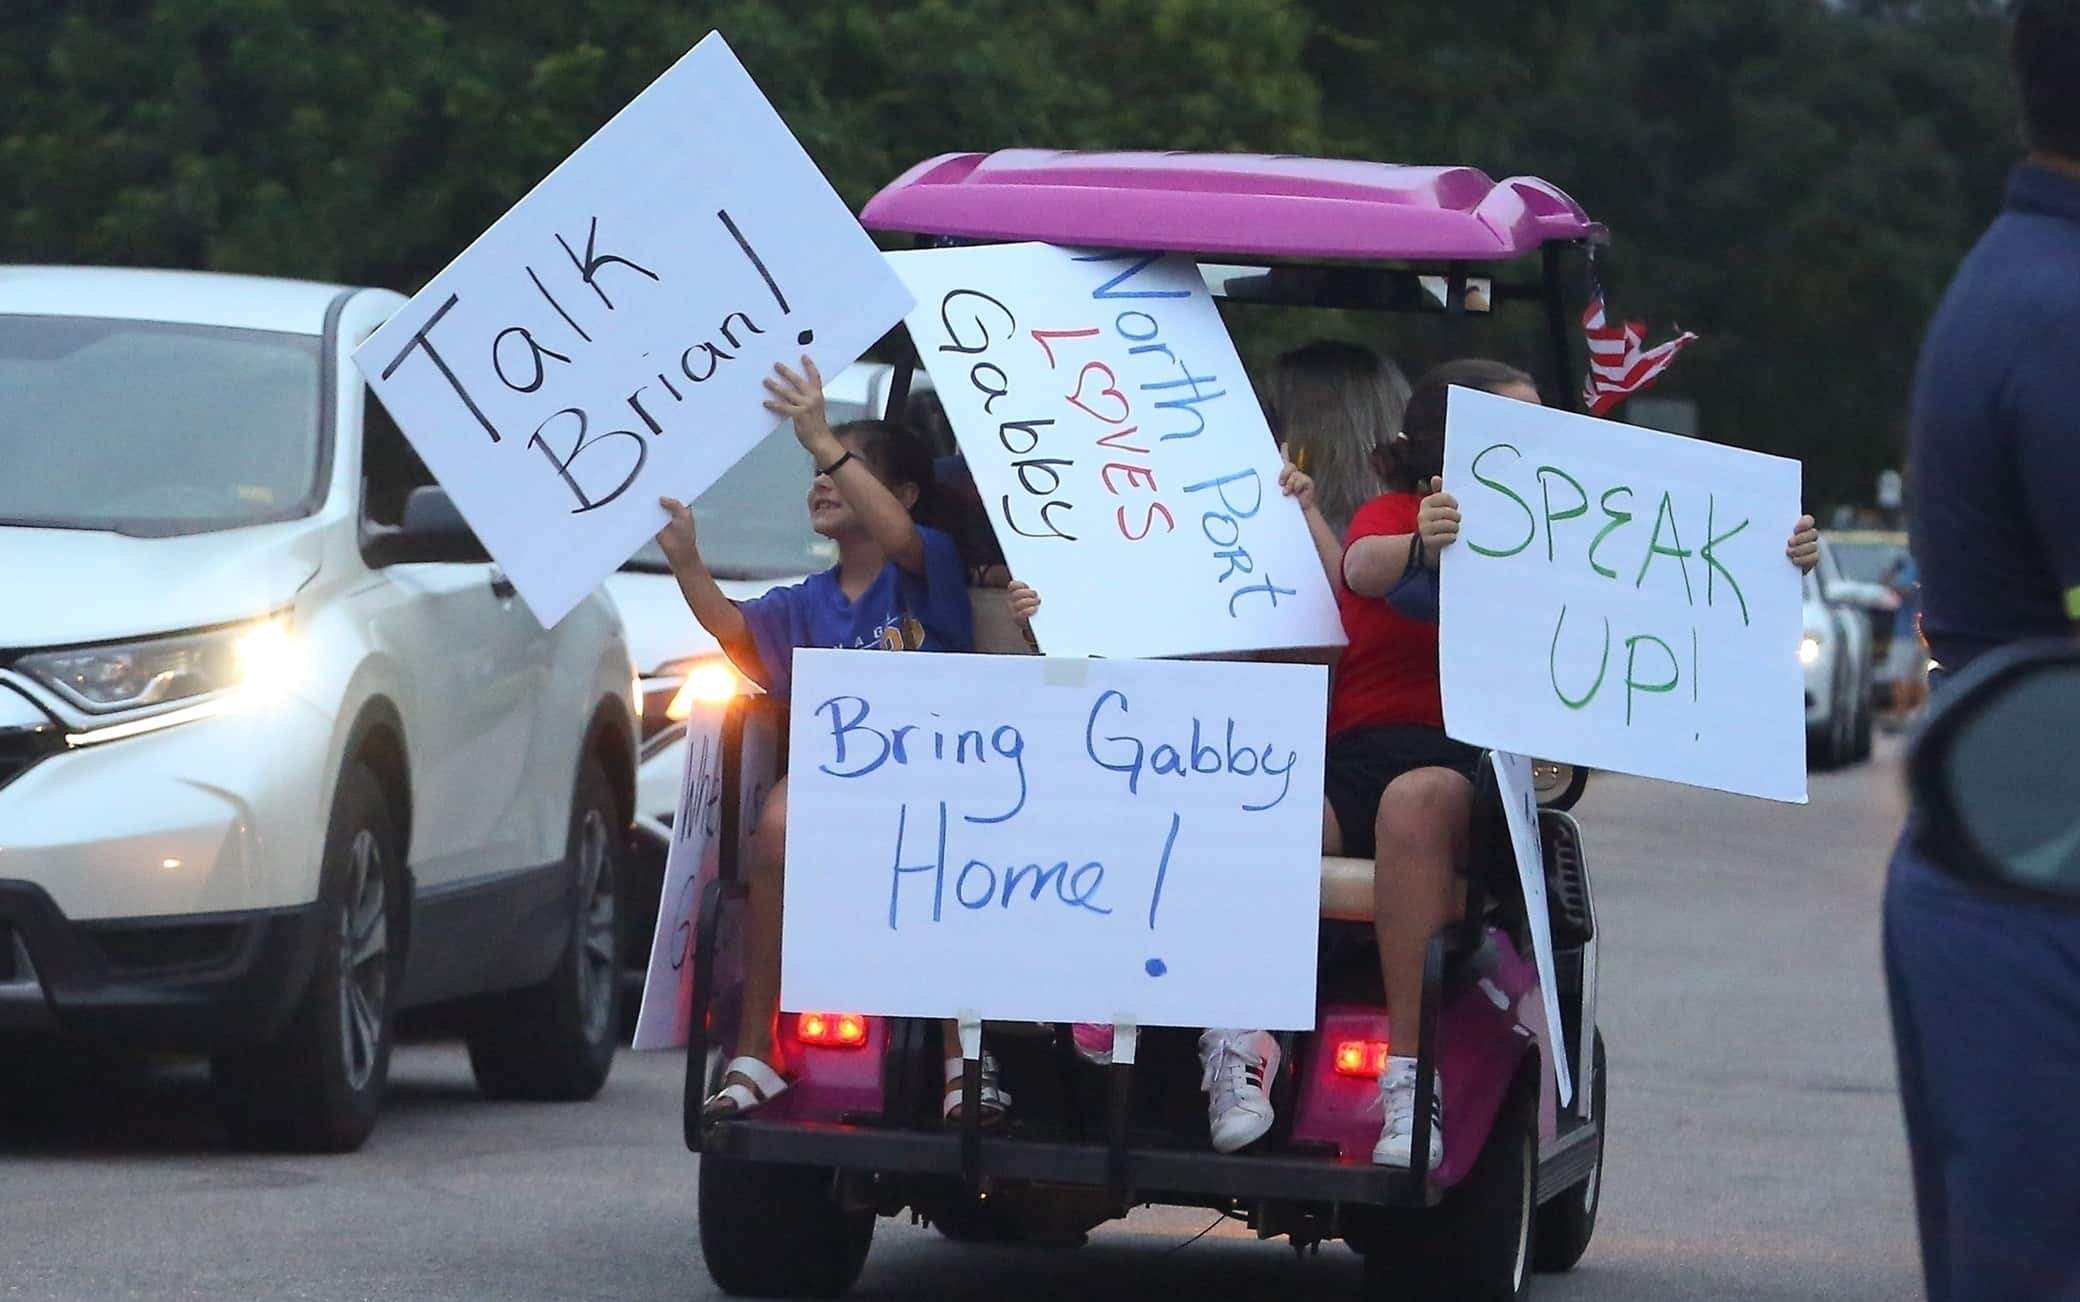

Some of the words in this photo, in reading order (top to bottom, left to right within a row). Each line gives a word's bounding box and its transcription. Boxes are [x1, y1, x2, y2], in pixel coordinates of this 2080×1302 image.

[381, 216, 659, 443] Talk
[527, 209, 816, 515] Brian!
[939, 288, 1078, 542] Gabby
[1072, 252, 1227, 442] North
[1467, 444, 1750, 627] SPEAK
[815, 695, 1028, 823] Bring
[1086, 689, 1297, 811] Gabby
[1550, 604, 1701, 742] UP!
